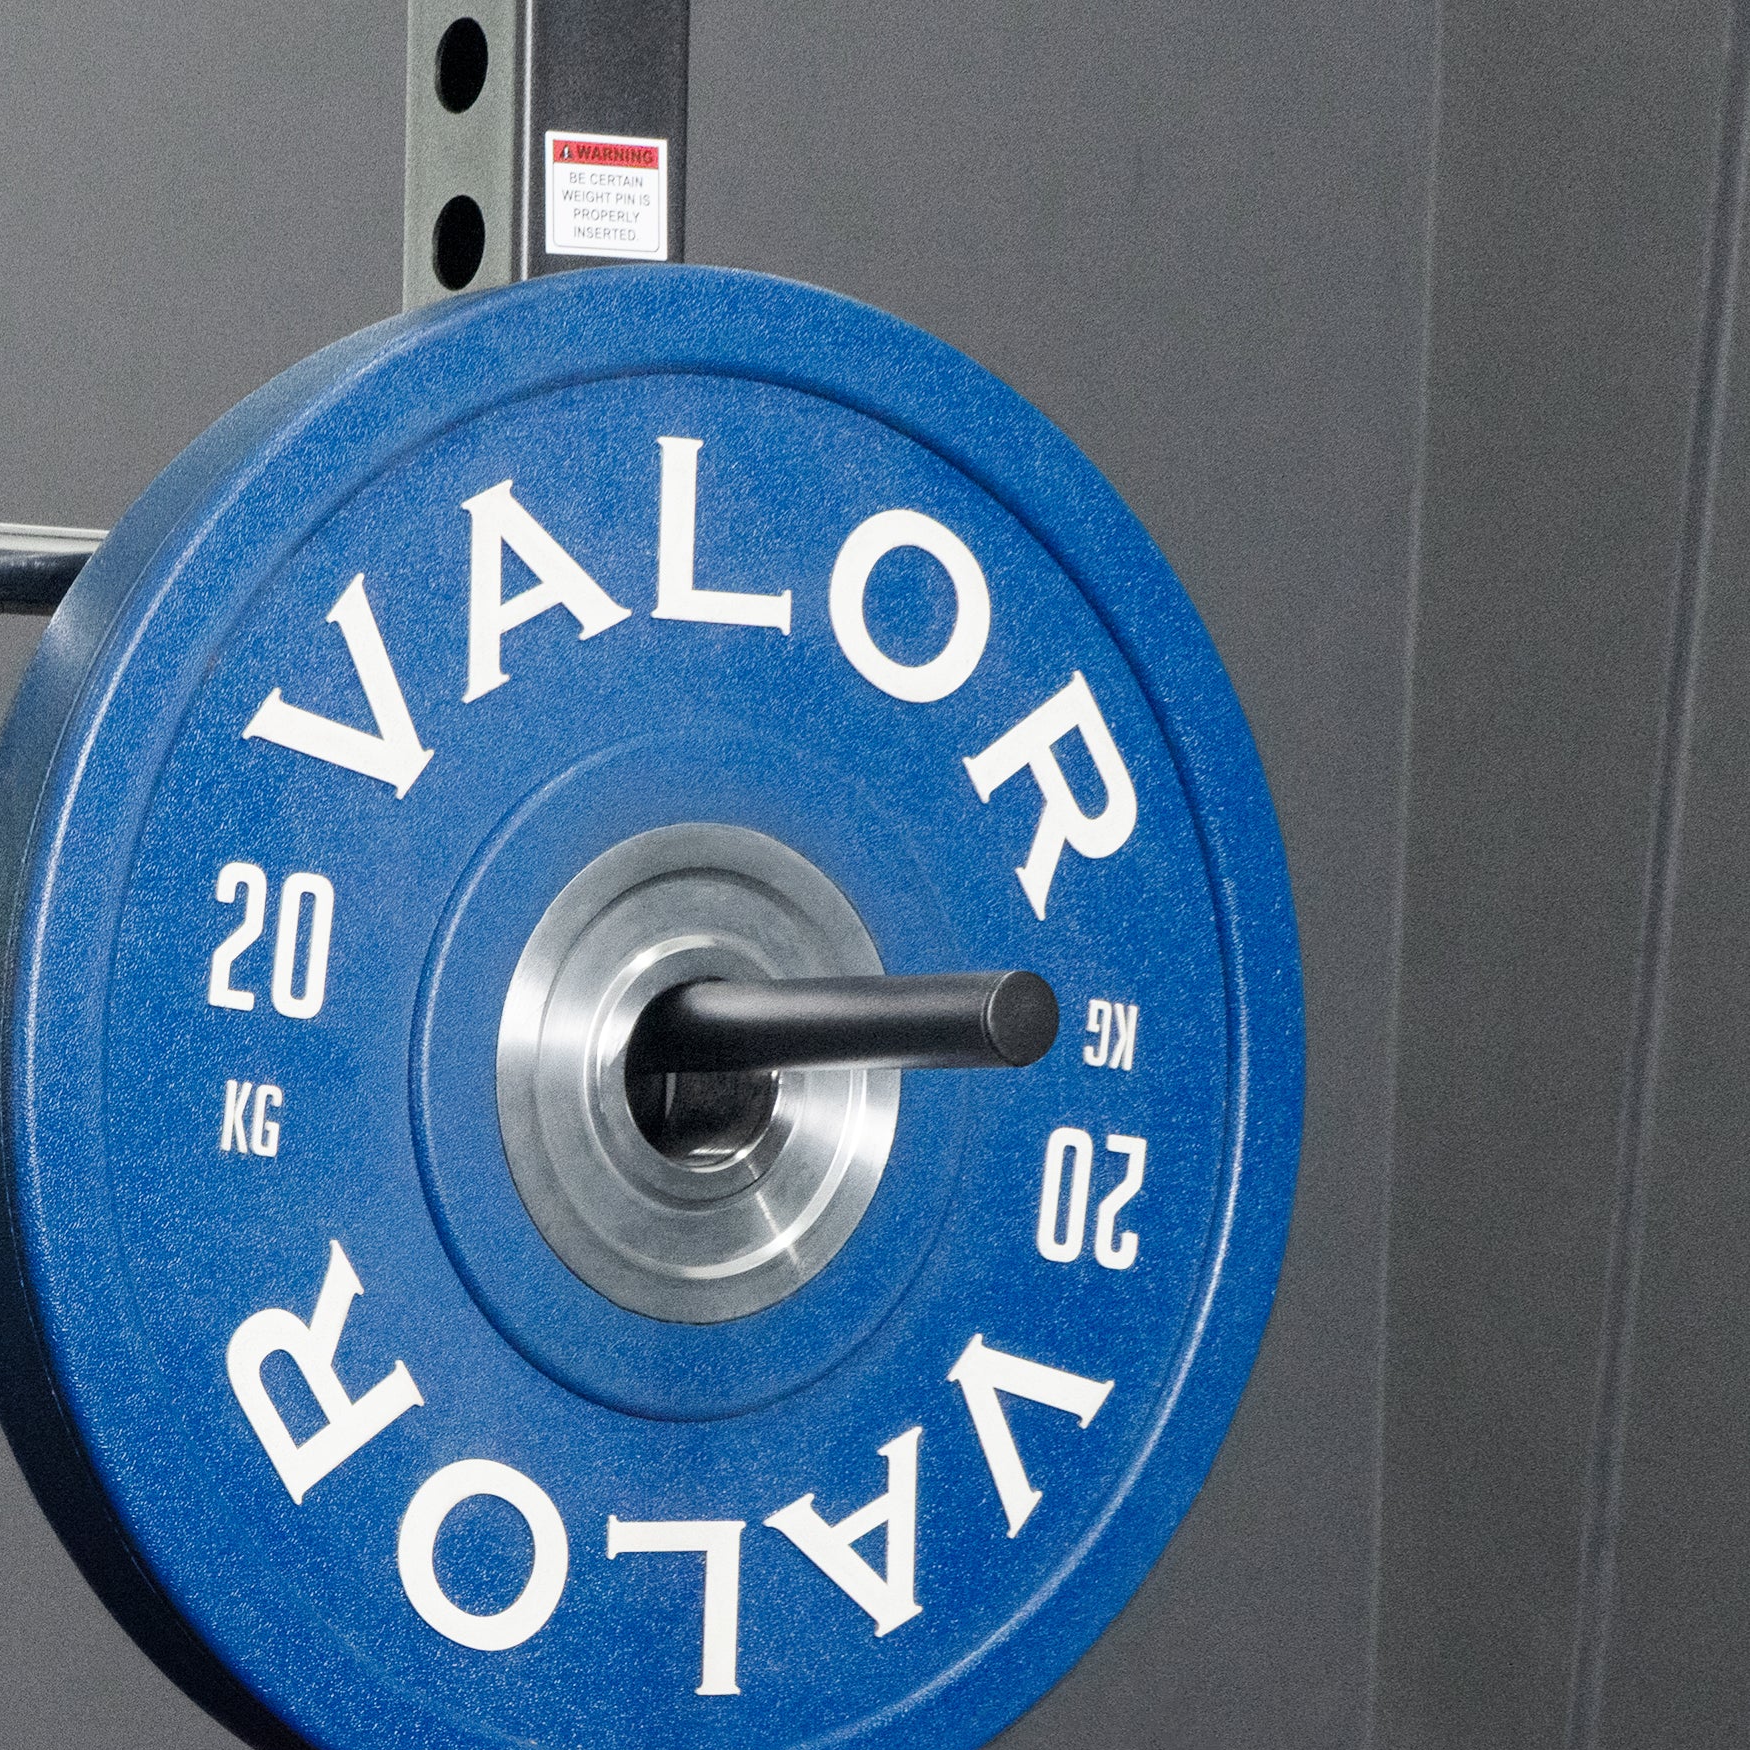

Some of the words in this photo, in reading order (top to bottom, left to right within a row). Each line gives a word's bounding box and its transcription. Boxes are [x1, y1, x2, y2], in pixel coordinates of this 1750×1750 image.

[570, 172, 586, 184] BE
[590, 173, 643, 187] CERTAIN
[577, 145, 653, 164] WARNING
[562, 190, 611, 204] WEIGHT
[616, 192, 635, 205] PIN
[639, 194, 650, 206] IS
[573, 208, 640, 223] PROPERLY
[573, 226, 639, 241] INSERTED.
[242, 434, 1139, 923] VALOR
[207, 860, 336, 1020] 20
[1083, 999, 1139, 1071] KG
[219, 1079, 285, 1158] KG
[1035, 1126, 1148, 1271] 20
[225, 1237, 1116, 1697] VALOR
